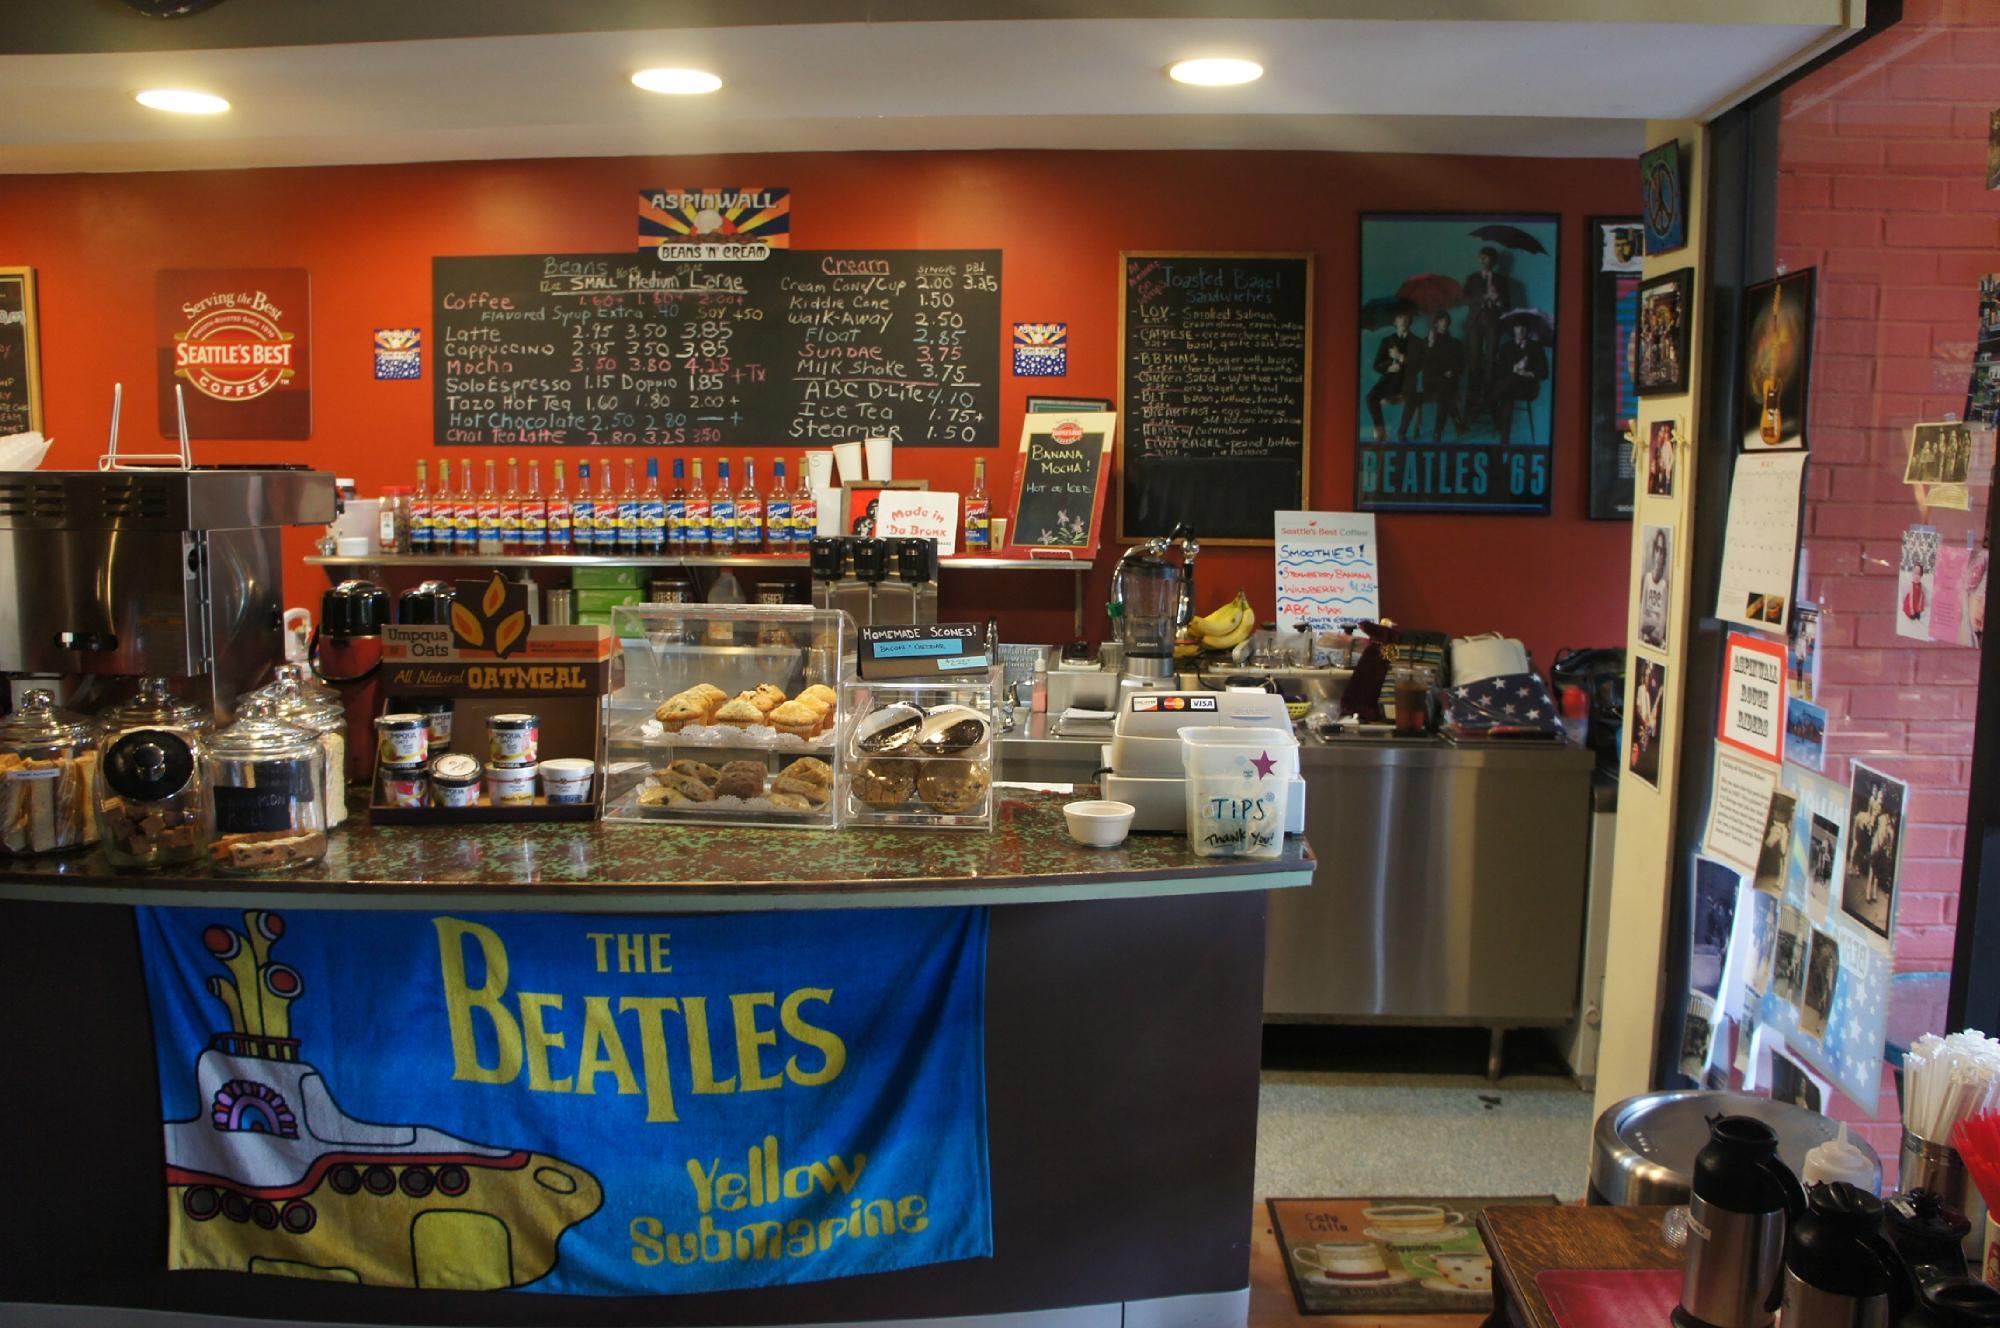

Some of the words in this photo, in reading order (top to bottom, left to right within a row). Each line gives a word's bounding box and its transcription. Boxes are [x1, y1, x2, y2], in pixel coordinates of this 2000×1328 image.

[651, 192, 776, 209] ASPINWALL
[662, 246, 702, 259] BEANS
[705, 246, 720, 259] 'N'
[723, 246, 767, 259] CREAM
[544, 257, 608, 275] Beans
[821, 256, 890, 274] Cream
[570, 275, 617, 290] SMALL
[628, 270, 680, 290] Medium
[690, 269, 744, 290] Large
[780, 276, 826, 292] Cream
[916, 276, 954, 290] 2.00
[962, 274, 999, 291] 3.25
[1163, 265, 1224, 289] Toasted
[1233, 268, 1281, 290] Bagel
[443, 292, 515, 310] Coffee
[789, 296, 844, 311] Kiddie
[852, 296, 889, 311] Cone
[919, 292, 954, 307] 1.50
[1186, 288, 1273, 304] Sandwiches
[182, 292, 235, 320] Serving
[237, 292, 252, 305] the
[251, 291, 283, 321] Best
[1182, 305, 1230, 320] Smoked
[552, 305, 591, 327] Syrup
[597, 306, 644, 320] Extra
[914, 312, 963, 328] 2.50
[444, 325, 502, 342] Latte
[572, 323, 613, 340] 2.95
[626, 323, 668, 340] 3.50
[680, 321, 734, 340] 3.85
[805, 328, 862, 343] Float
[913, 329, 967, 344] 2.85
[176, 342, 251, 366] SEATTLE'S
[253, 343, 292, 366] BEST
[572, 341, 616, 357] 2.95
[675, 339, 730, 359] 3.85
[916, 346, 963, 362] 3.75
[447, 354, 513, 375] Mocha
[569, 358, 617, 374] 3.50
[629, 358, 672, 373] 3.80
[684, 356, 731, 374] 4.25
[848, 359, 907, 378] Shake
[919, 363, 966, 384] 3.75
[199, 376, 269, 397] COFFEE
[445, 378, 485, 393] Solo
[488, 377, 572, 400] Espresso
[584, 374, 615, 390] 1.15
[621, 374, 678, 396] Doppio
[689, 373, 725, 390] 1.85
[1185, 372, 1216, 384] Salad
[446, 395, 495, 412] Tazo
[503, 395, 538, 411] Hot
[543, 395, 572, 411] Tea
[586, 395, 619, 411] 1.60
[635, 394, 671, 410] 1.80
[689, 395, 725, 410] 2.00
[804, 381, 859, 400] ABC
[927, 388, 975, 408] 4.10
[1142, 390, 1167, 402] BLT
[449, 414, 485, 430] Hot
[488, 411, 586, 431] Chocolate
[591, 413, 635, 431] 2.50
[799, 402, 849, 419] Ice
[856, 402, 893, 419] Tea
[928, 408, 985, 424] 1.75+
[446, 428, 483, 443] Chai
[492, 429, 516, 443] Tea
[518, 428, 568, 444] Latte
[588, 430, 637, 446] 2.80
[642, 429, 686, 446] 3.25
[926, 425, 977, 443] 1.50
[1032, 444, 1084, 461] BANANA
[1362, 450, 1489, 495] BEATLES
[1503, 453, 1547, 496] '65
[1026, 482, 1046, 493] HOT
[1067, 482, 1092, 494] ICED
[891, 506, 929, 522] Made
[932, 509, 945, 524] in
[911, 524, 948, 537] Bronx
[1280, 527, 1317, 536] Seattle's
[1318, 528, 1339, 536] Best
[1339, 528, 1369, 537] Coffee
[1283, 604, 1311, 615] ABC
[388, 628, 448, 643] Umpqua
[863, 627, 921, 640] HOMEMADE
[930, 624, 977, 637] SCONES!
[411, 643, 449, 657] Oats
[393, 670, 414, 684] All
[416, 669, 466, 684] Natural
[467, 666, 586, 690] OATMEAL
[1192, 699, 1214, 708] VISA
[1212, 798, 1265, 821] TIPS
[1204, 828, 1247, 847] Thank
[586, 932, 673, 975] THE
[432, 915, 849, 1123] BEATLES
[685, 1135, 868, 1214] Yellow
[629, 1193, 930, 1267] Submarine
[1309, 1221, 1349, 1233] Latte
